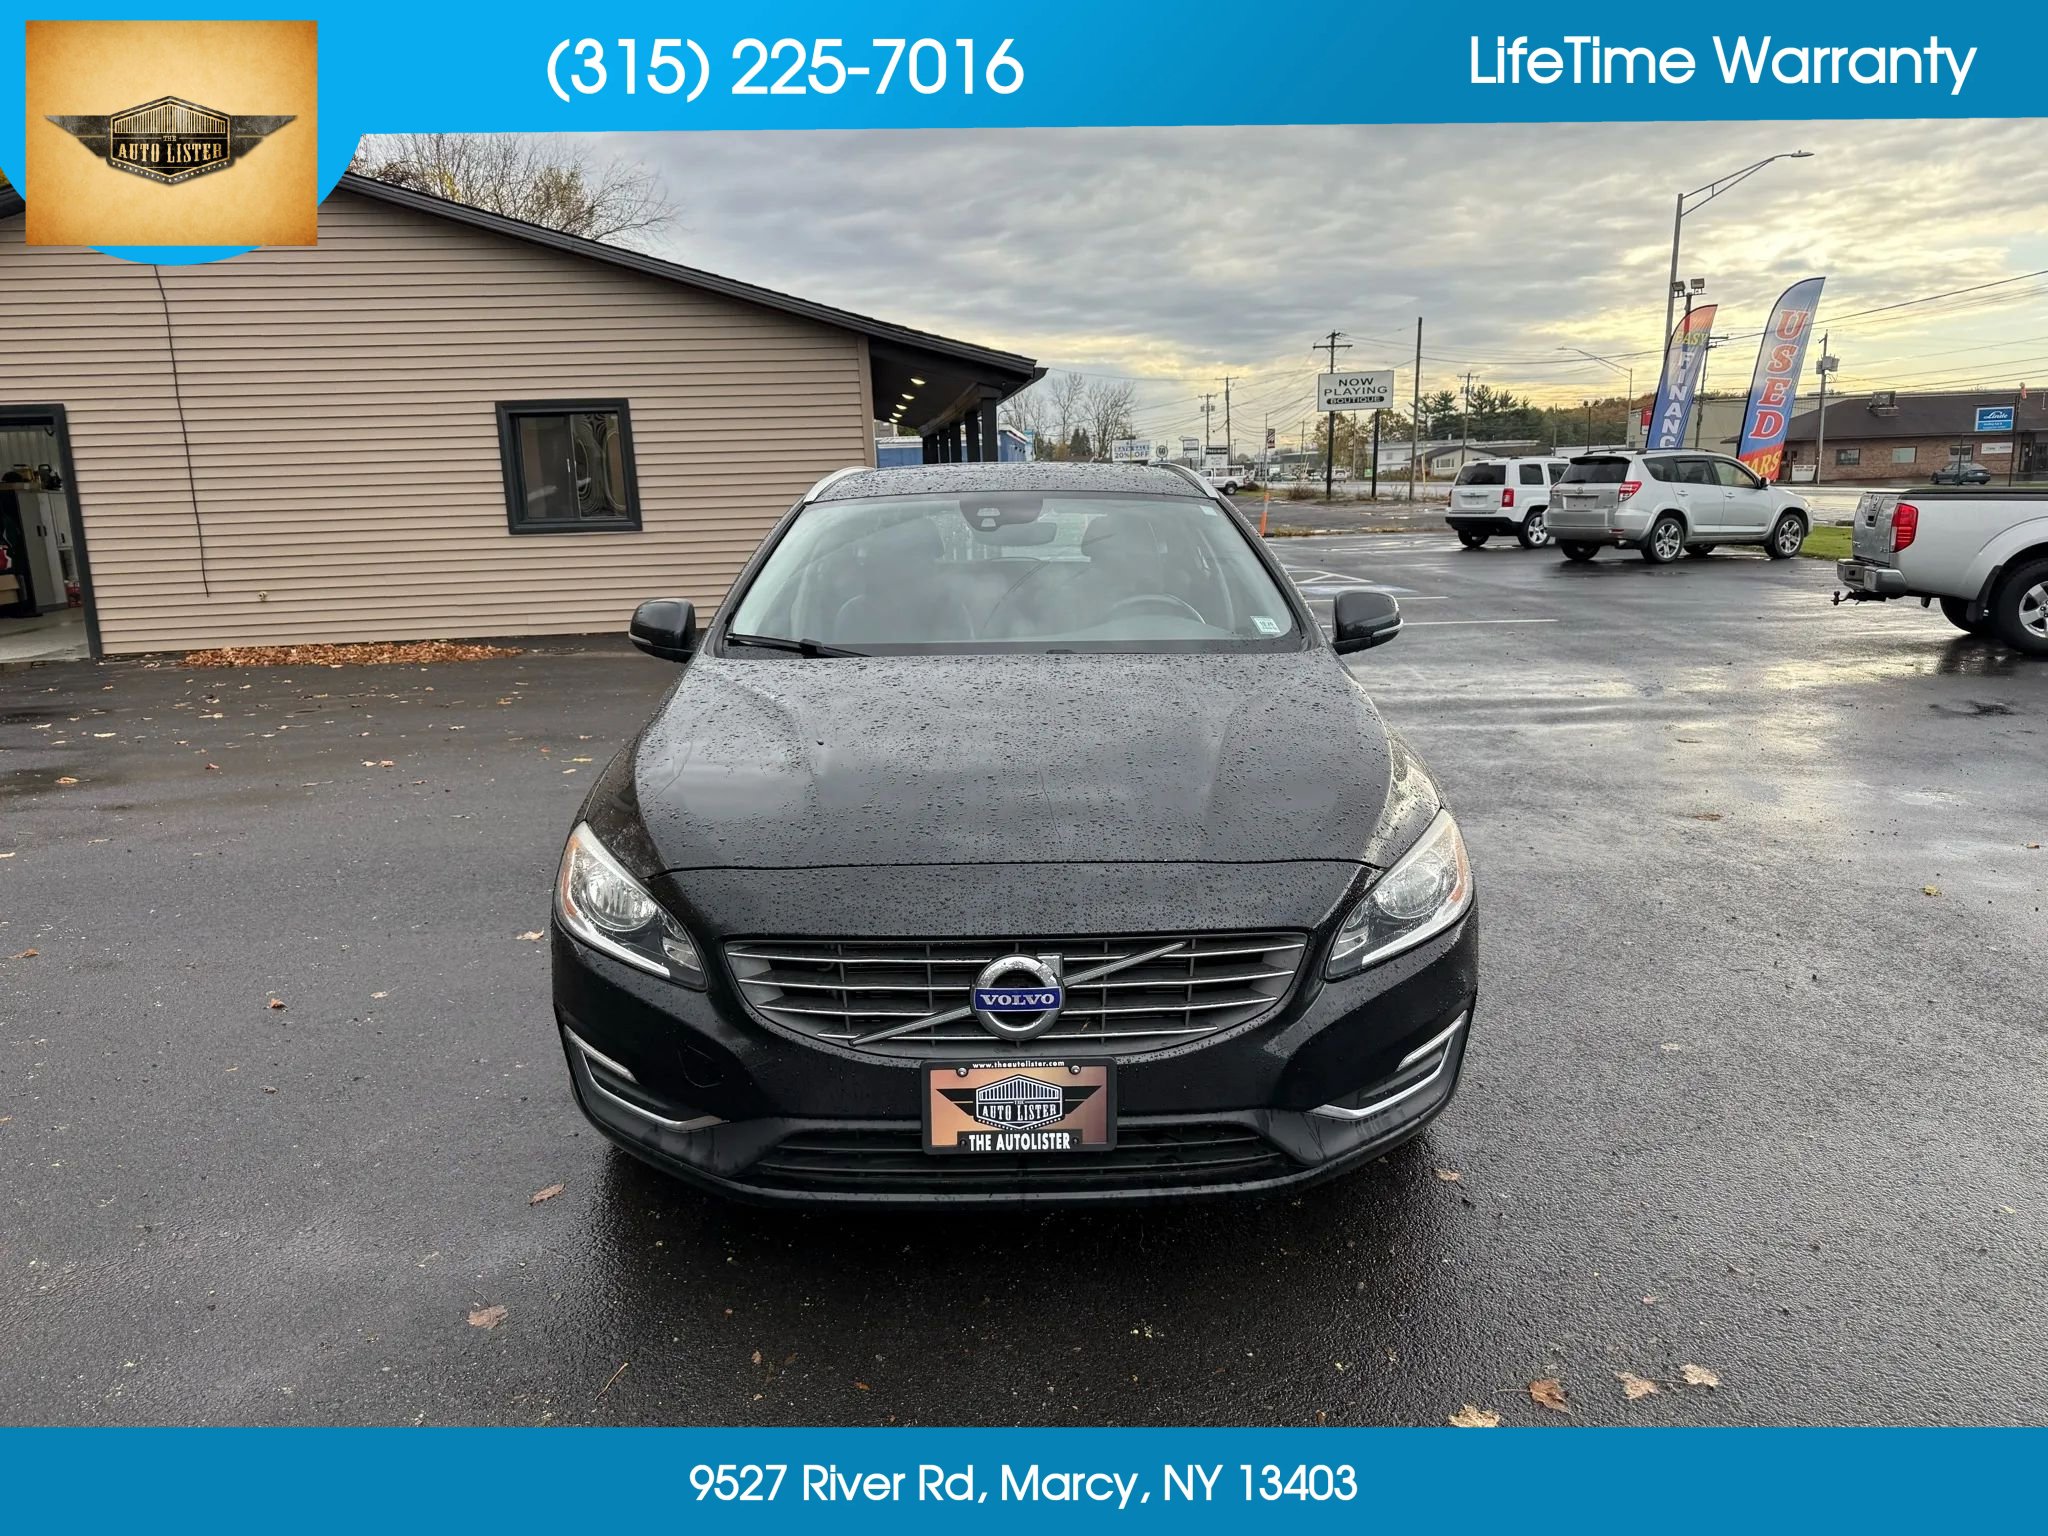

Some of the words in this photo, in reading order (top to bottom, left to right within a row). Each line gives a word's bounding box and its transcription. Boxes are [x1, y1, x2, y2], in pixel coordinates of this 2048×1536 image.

[1674, 331, 1708, 346] EASY
[1748, 309, 1809, 440] USED
[1338, 377, 1374, 387] NOW
[1324, 386, 1388, 396] PLAYING
[1331, 396, 1381, 404] BOUTIQUE
[1983, 411, 2008, 419] Linde
[980, 994, 1055, 1006] VOLVO
[972, 1060, 1065, 1068] www.theautolister.com
[982, 1105, 1012, 1121] AUTO
[1017, 1104, 1057, 1121] LISTER
[969, 1134, 992, 1151] THE
[996, 1132, 1071, 1151] AUTOLISTER
